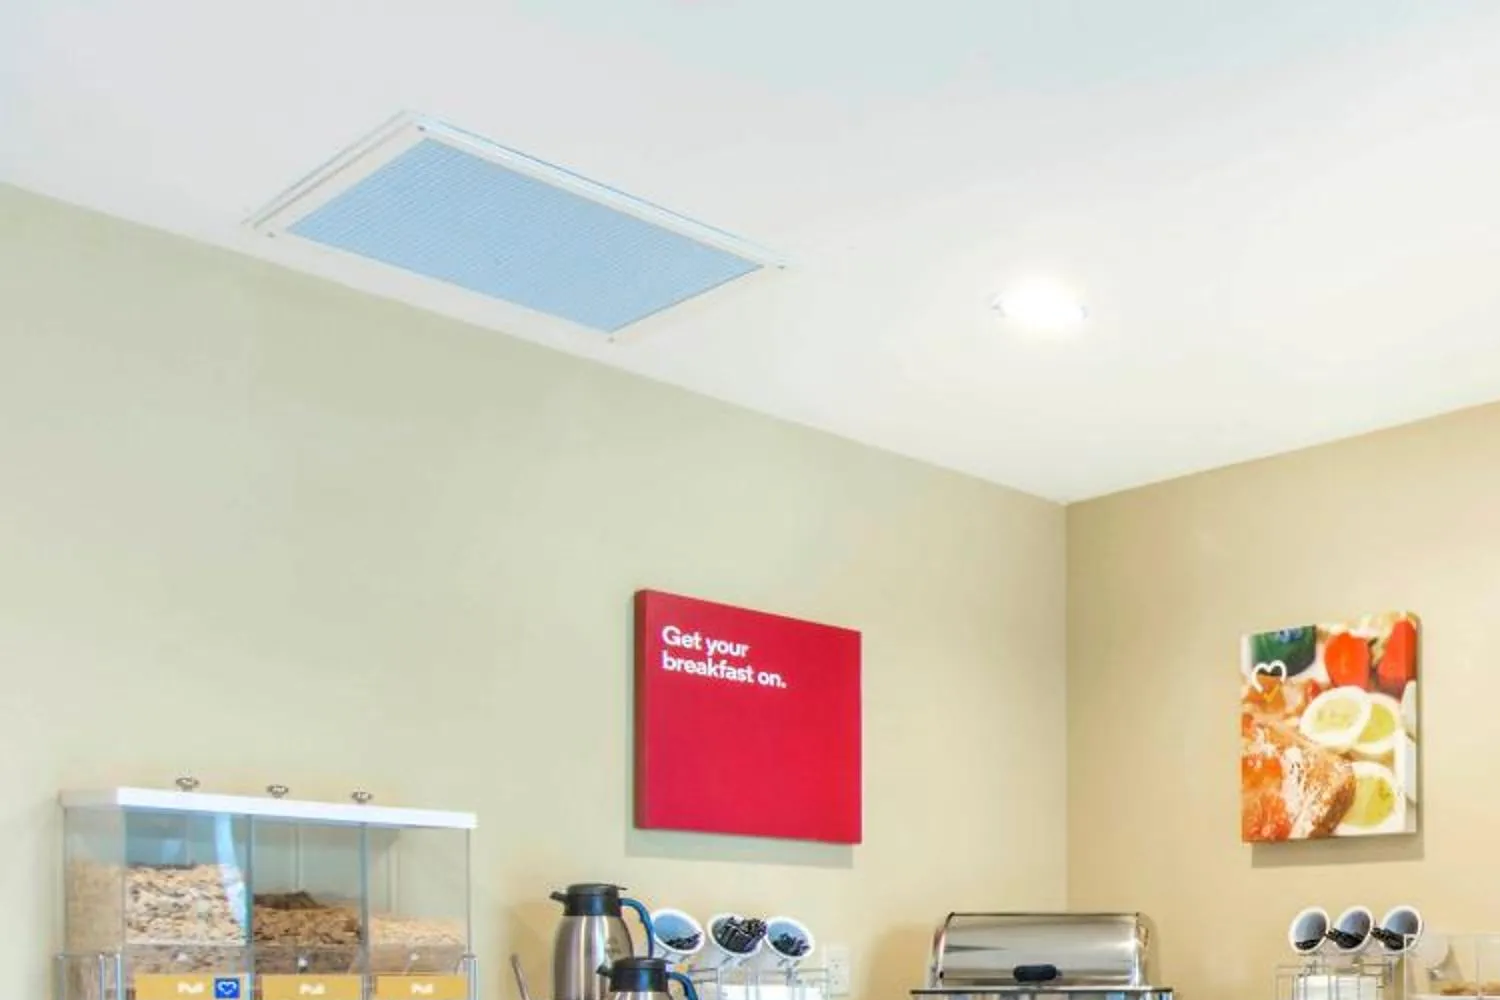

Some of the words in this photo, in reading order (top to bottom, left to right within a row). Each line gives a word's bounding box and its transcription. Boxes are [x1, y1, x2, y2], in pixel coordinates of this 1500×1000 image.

[661, 625, 703, 650] Get
[705, 636, 750, 657] your
[661, 649, 755, 684] breakfast
[757, 670, 788, 689] on.
